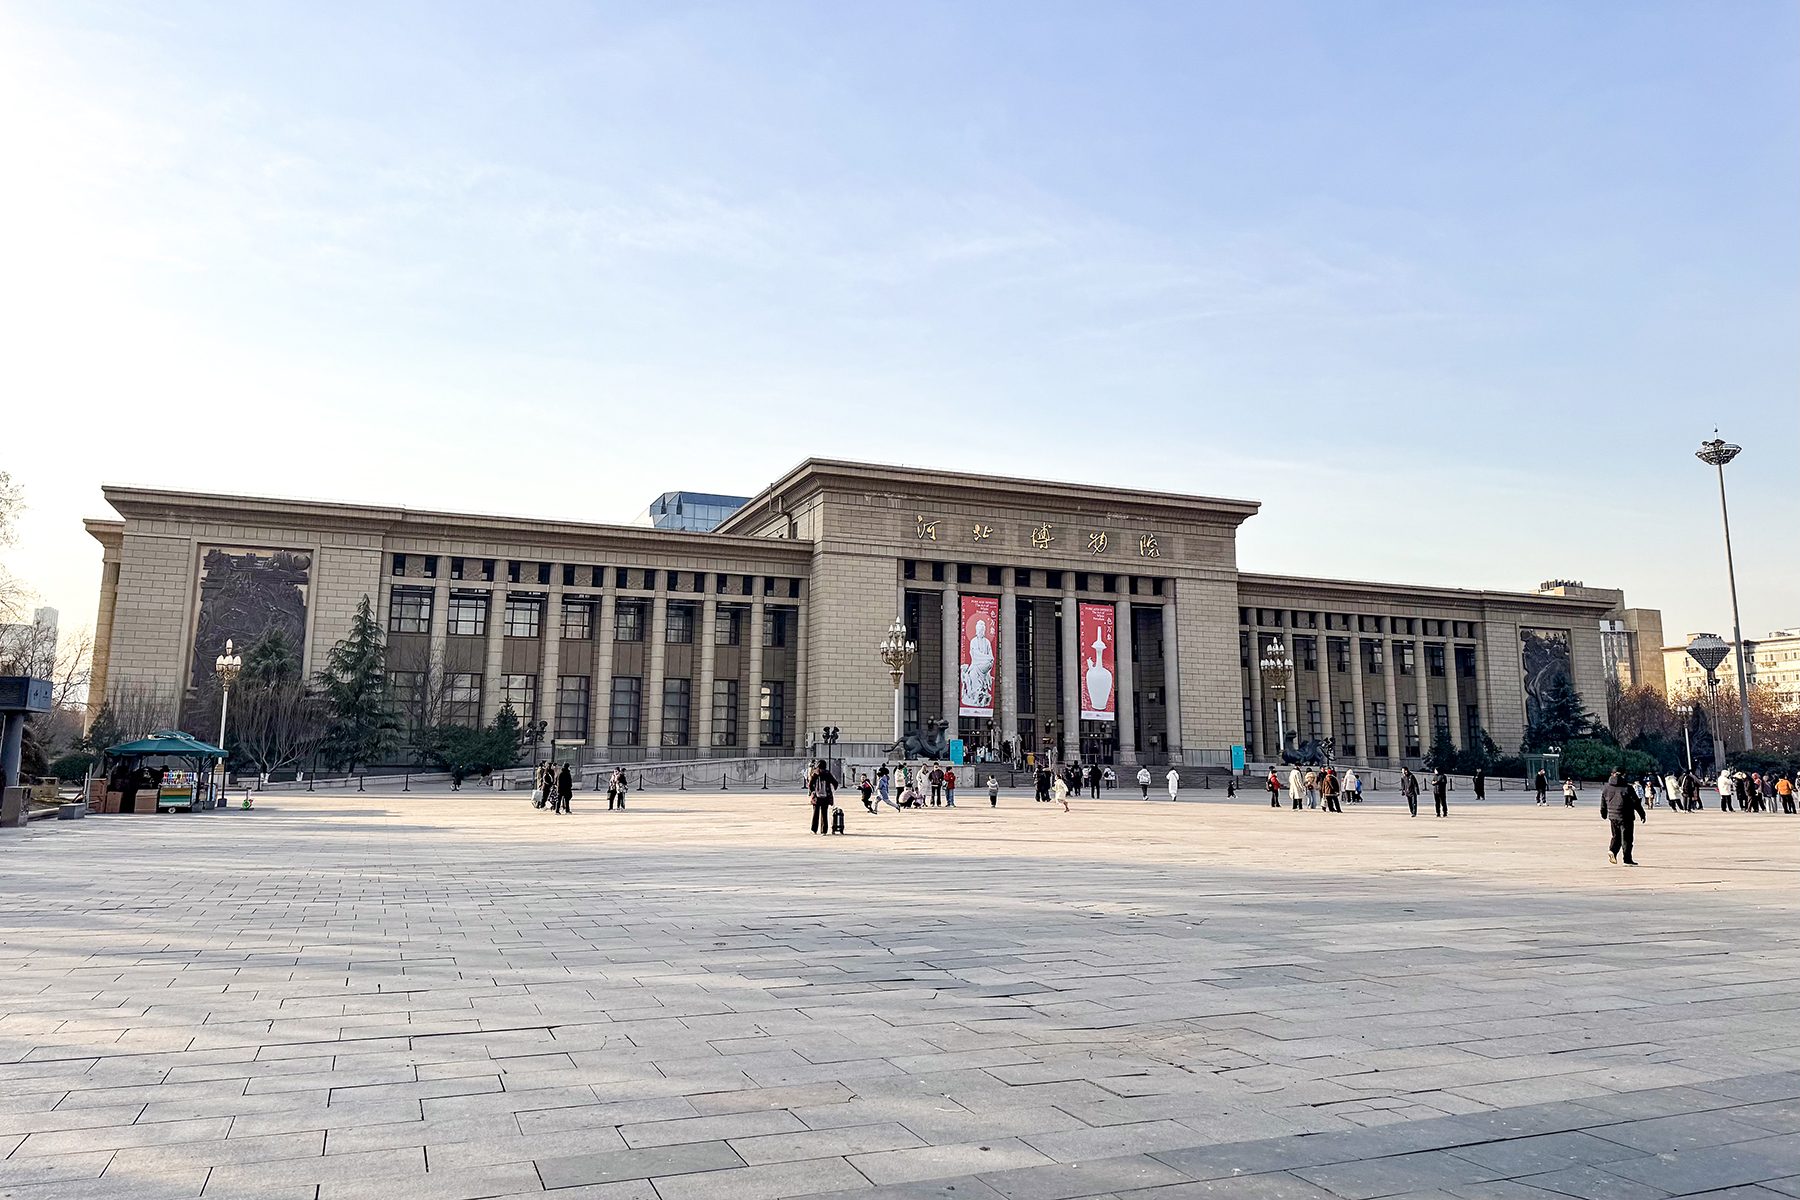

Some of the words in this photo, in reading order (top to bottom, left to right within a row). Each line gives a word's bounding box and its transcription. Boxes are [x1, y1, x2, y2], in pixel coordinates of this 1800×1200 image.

[916, 515, 1161, 558] 河北博物院
